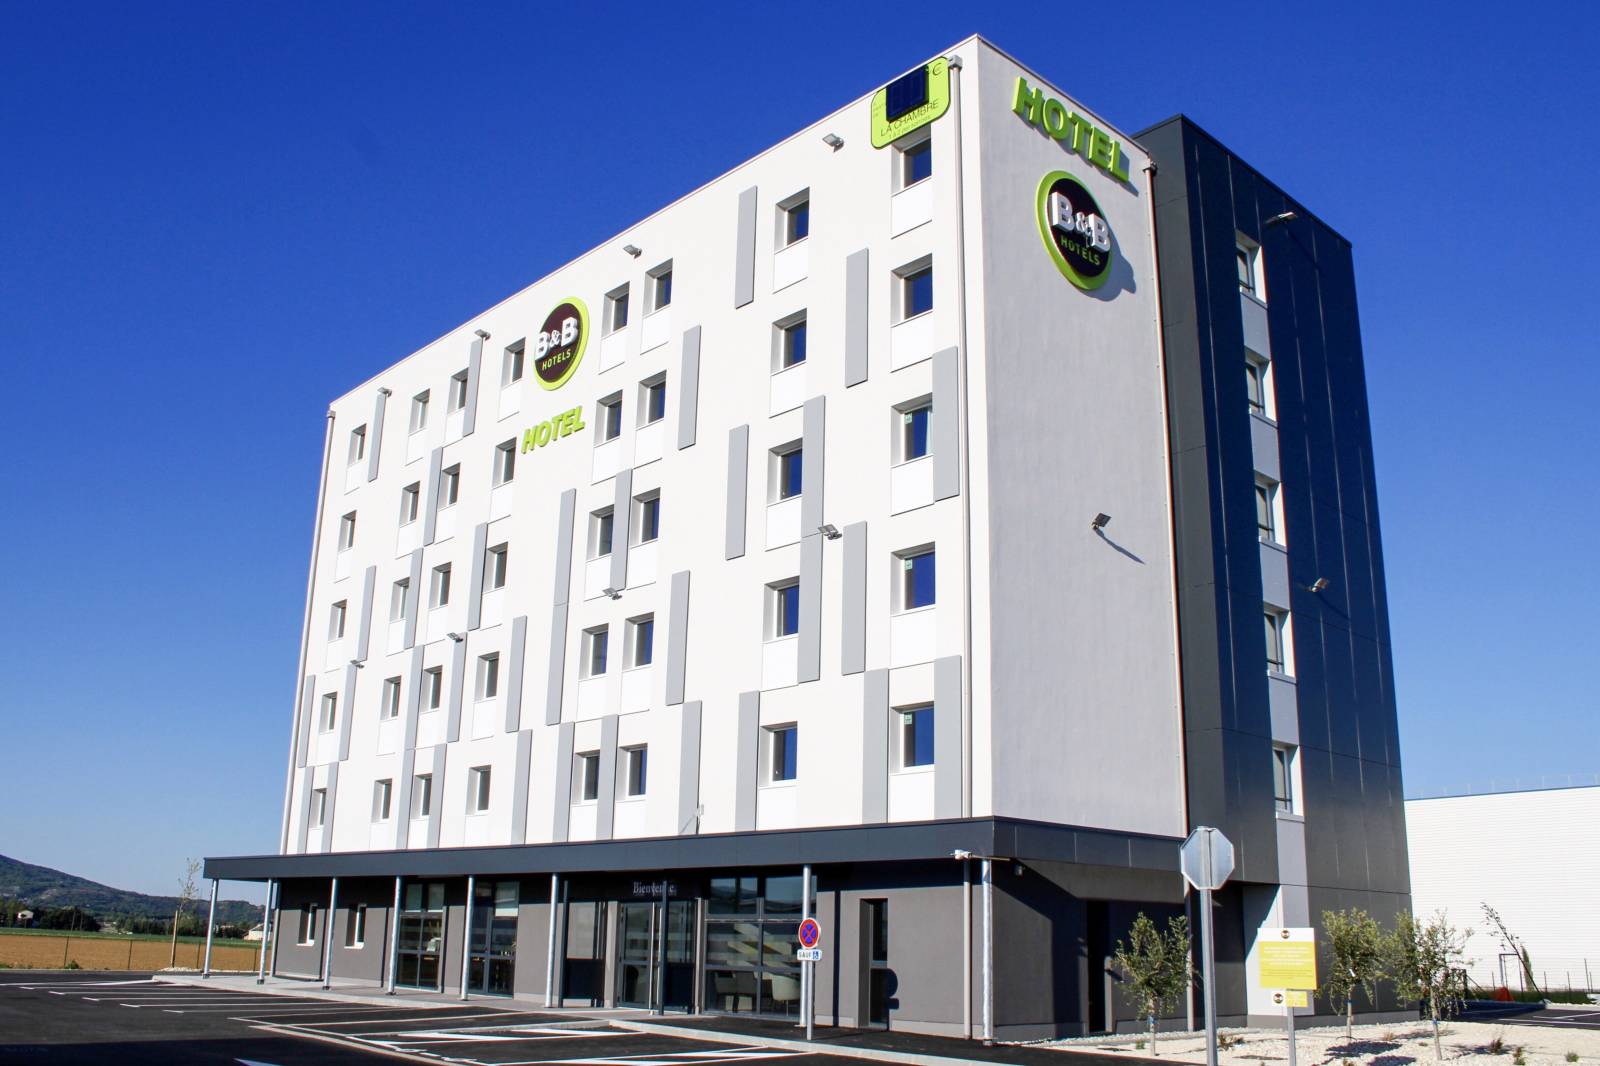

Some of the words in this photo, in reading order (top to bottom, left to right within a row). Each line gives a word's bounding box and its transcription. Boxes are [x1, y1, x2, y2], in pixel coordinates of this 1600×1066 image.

[880, 122, 893, 137] LA
[893, 98, 939, 129] CHAMBRE
[1012, 76, 1130, 183] HOTEL
[1050, 191, 1111, 252] B&B
[1060, 234, 1101, 266] HOTELS
[535, 316, 579, 361] B&B
[541, 348, 572, 371] HOTELS
[521, 405, 586, 455] HOTEL
